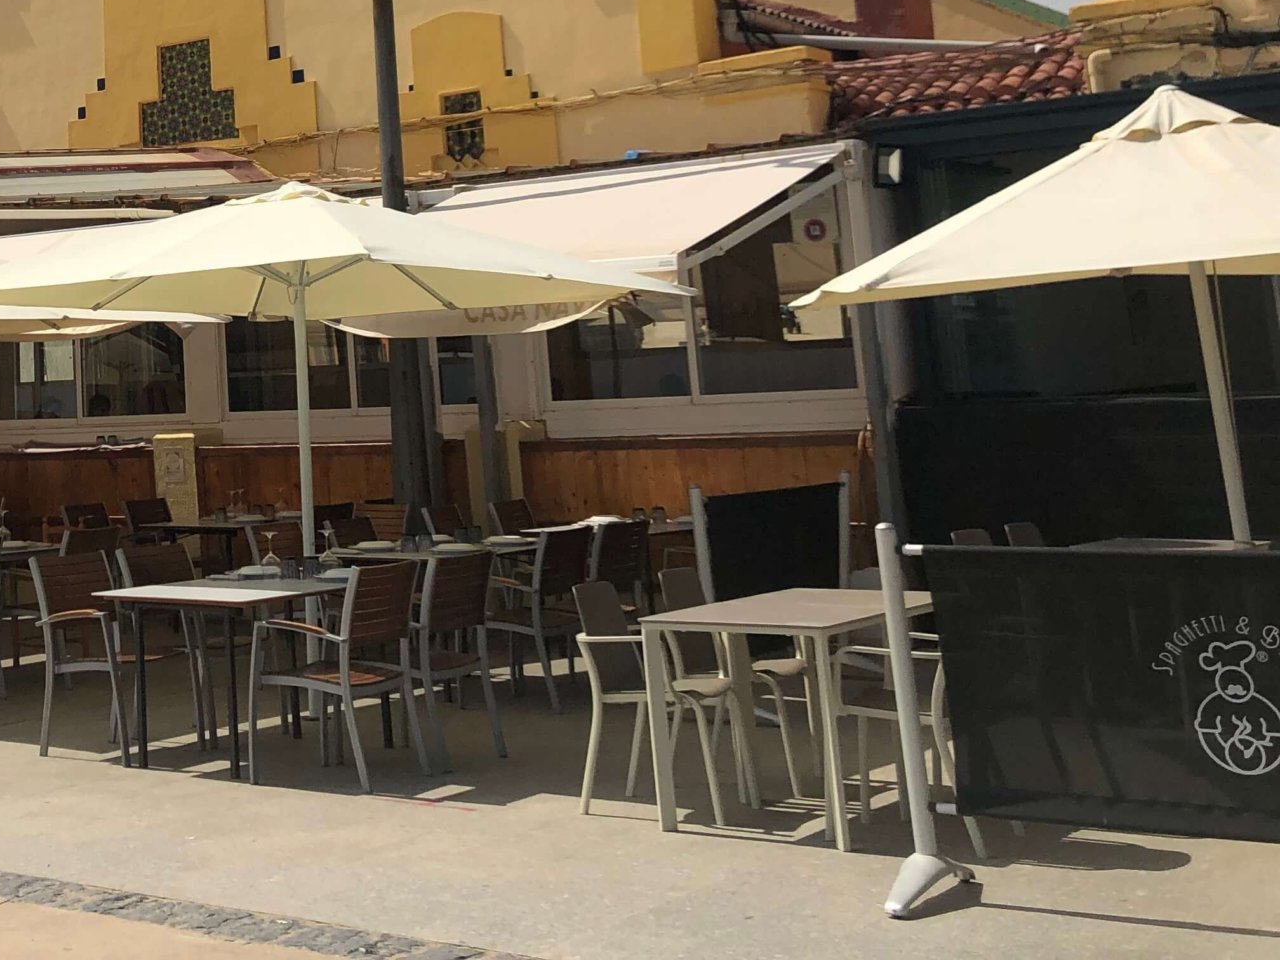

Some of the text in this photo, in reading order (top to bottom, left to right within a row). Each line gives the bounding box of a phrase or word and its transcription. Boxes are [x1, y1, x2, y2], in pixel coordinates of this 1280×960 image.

[464, 304, 527, 323] CASA
[1151, 615, 1226, 676] SPAGHETTI
[1235, 616, 1250, 635] &
